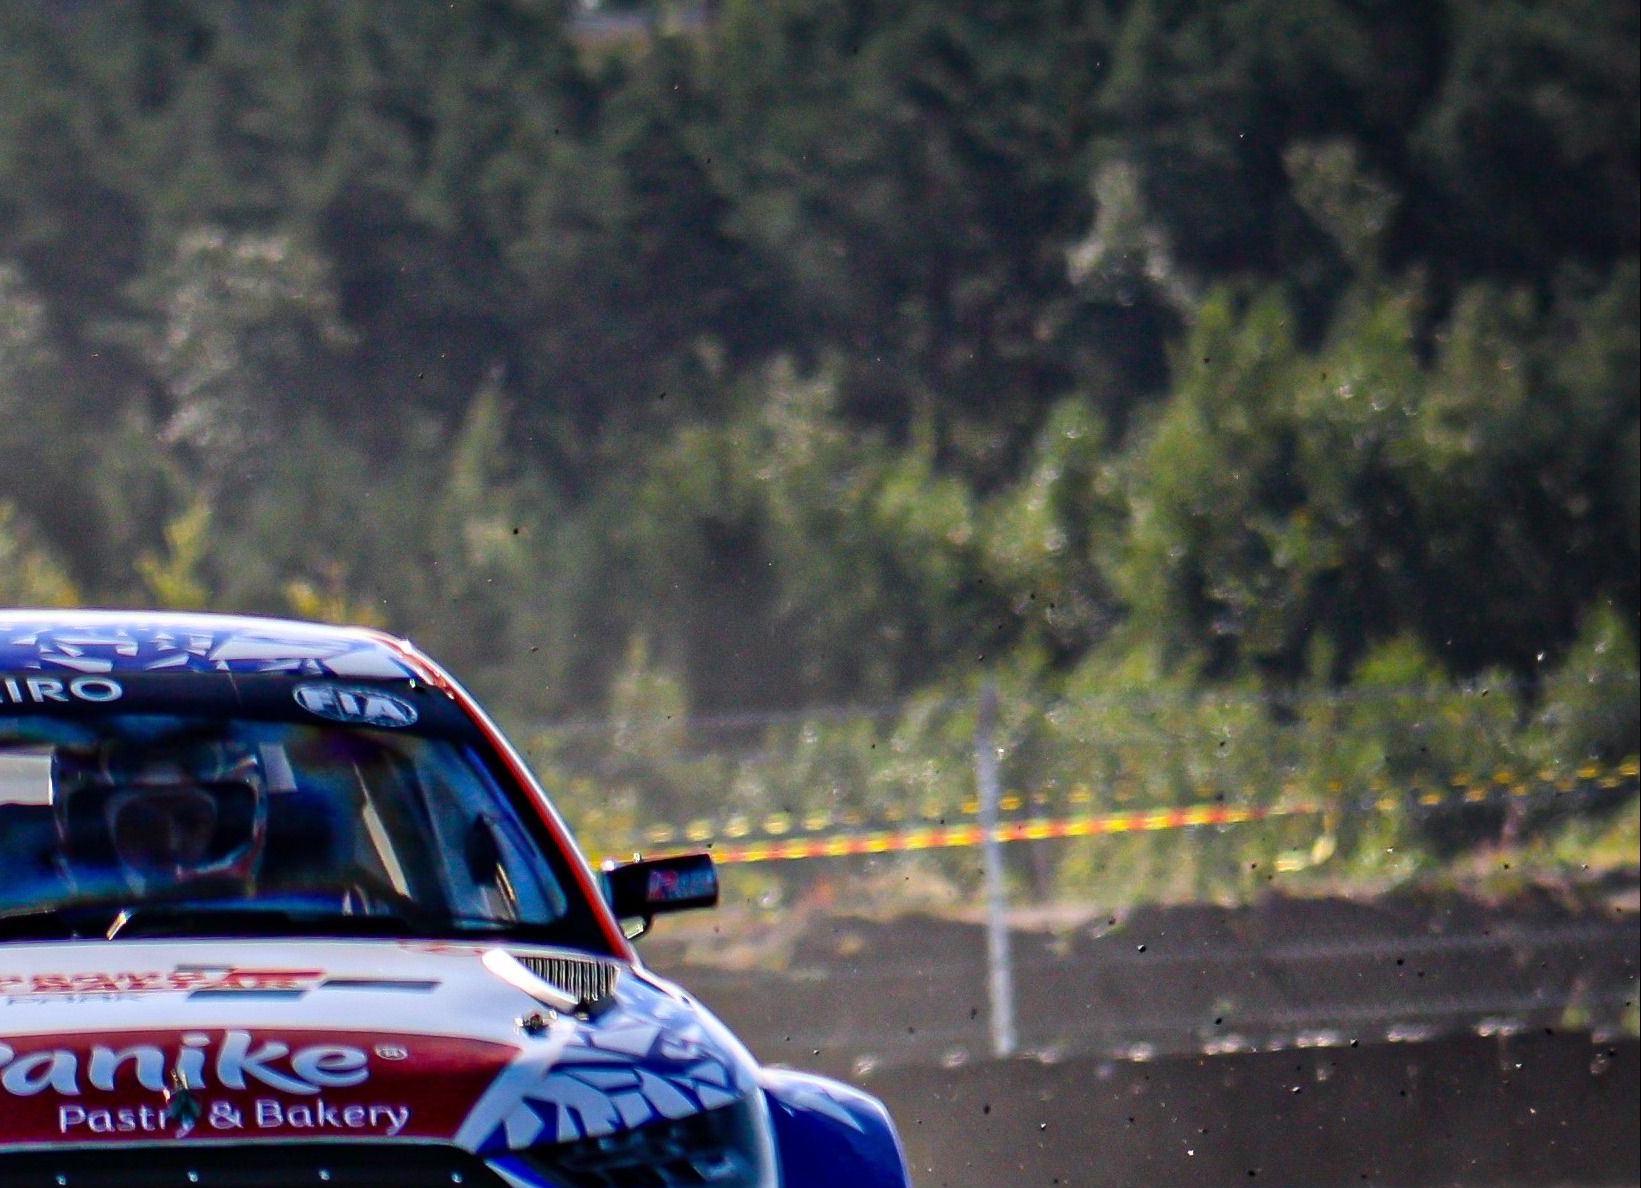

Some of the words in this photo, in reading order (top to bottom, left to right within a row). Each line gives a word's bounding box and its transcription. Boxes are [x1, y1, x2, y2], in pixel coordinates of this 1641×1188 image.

[300, 686, 408, 723] FIA
[209, 1101, 244, 1130] &
[256, 1098, 408, 1136] Bakery
